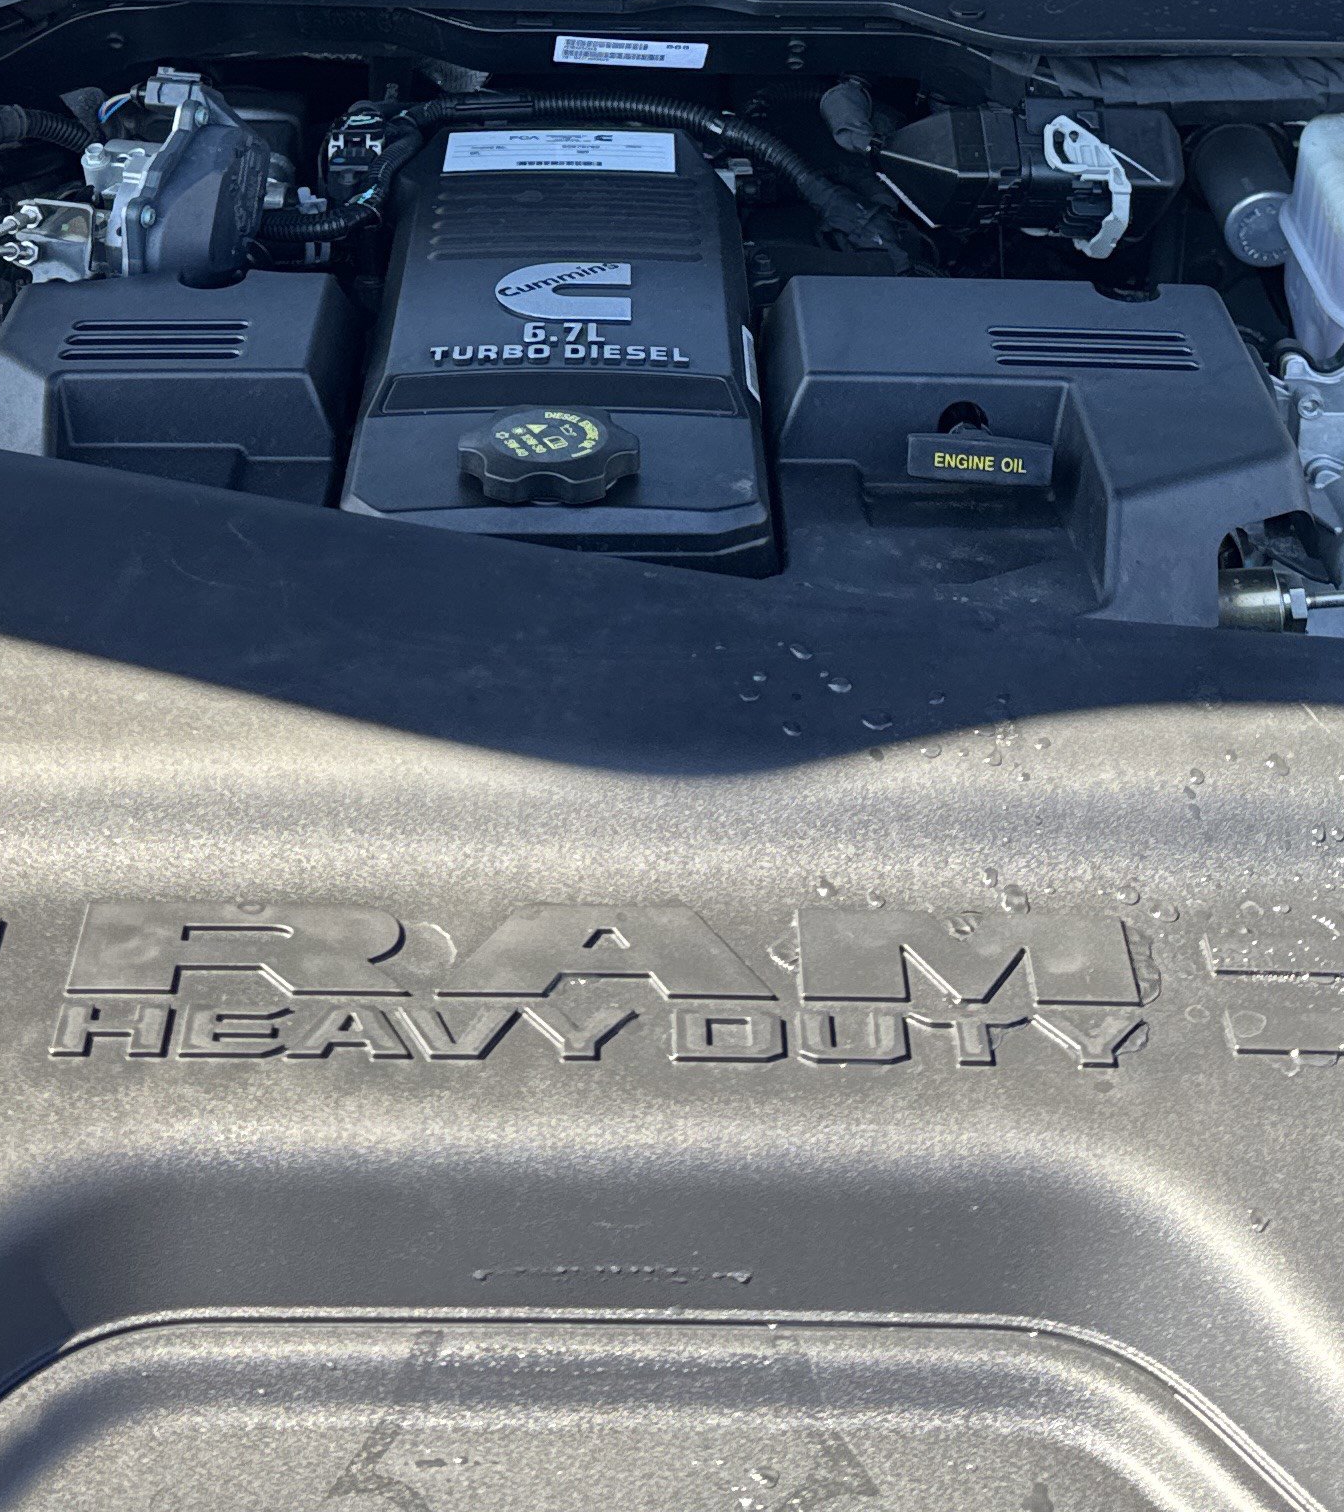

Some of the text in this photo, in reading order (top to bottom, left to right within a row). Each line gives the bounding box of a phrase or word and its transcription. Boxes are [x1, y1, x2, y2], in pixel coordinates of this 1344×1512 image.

[497, 262, 620, 297] Cummins
[523, 322, 606, 343] 6.7L
[430, 344, 690, 364] TURBO DIESEL
[934, 452, 1027, 474] ENGINE OIL
[64, 900, 1148, 1008] RAM
[48, 1004, 1149, 1069] HEAVY DUTY
